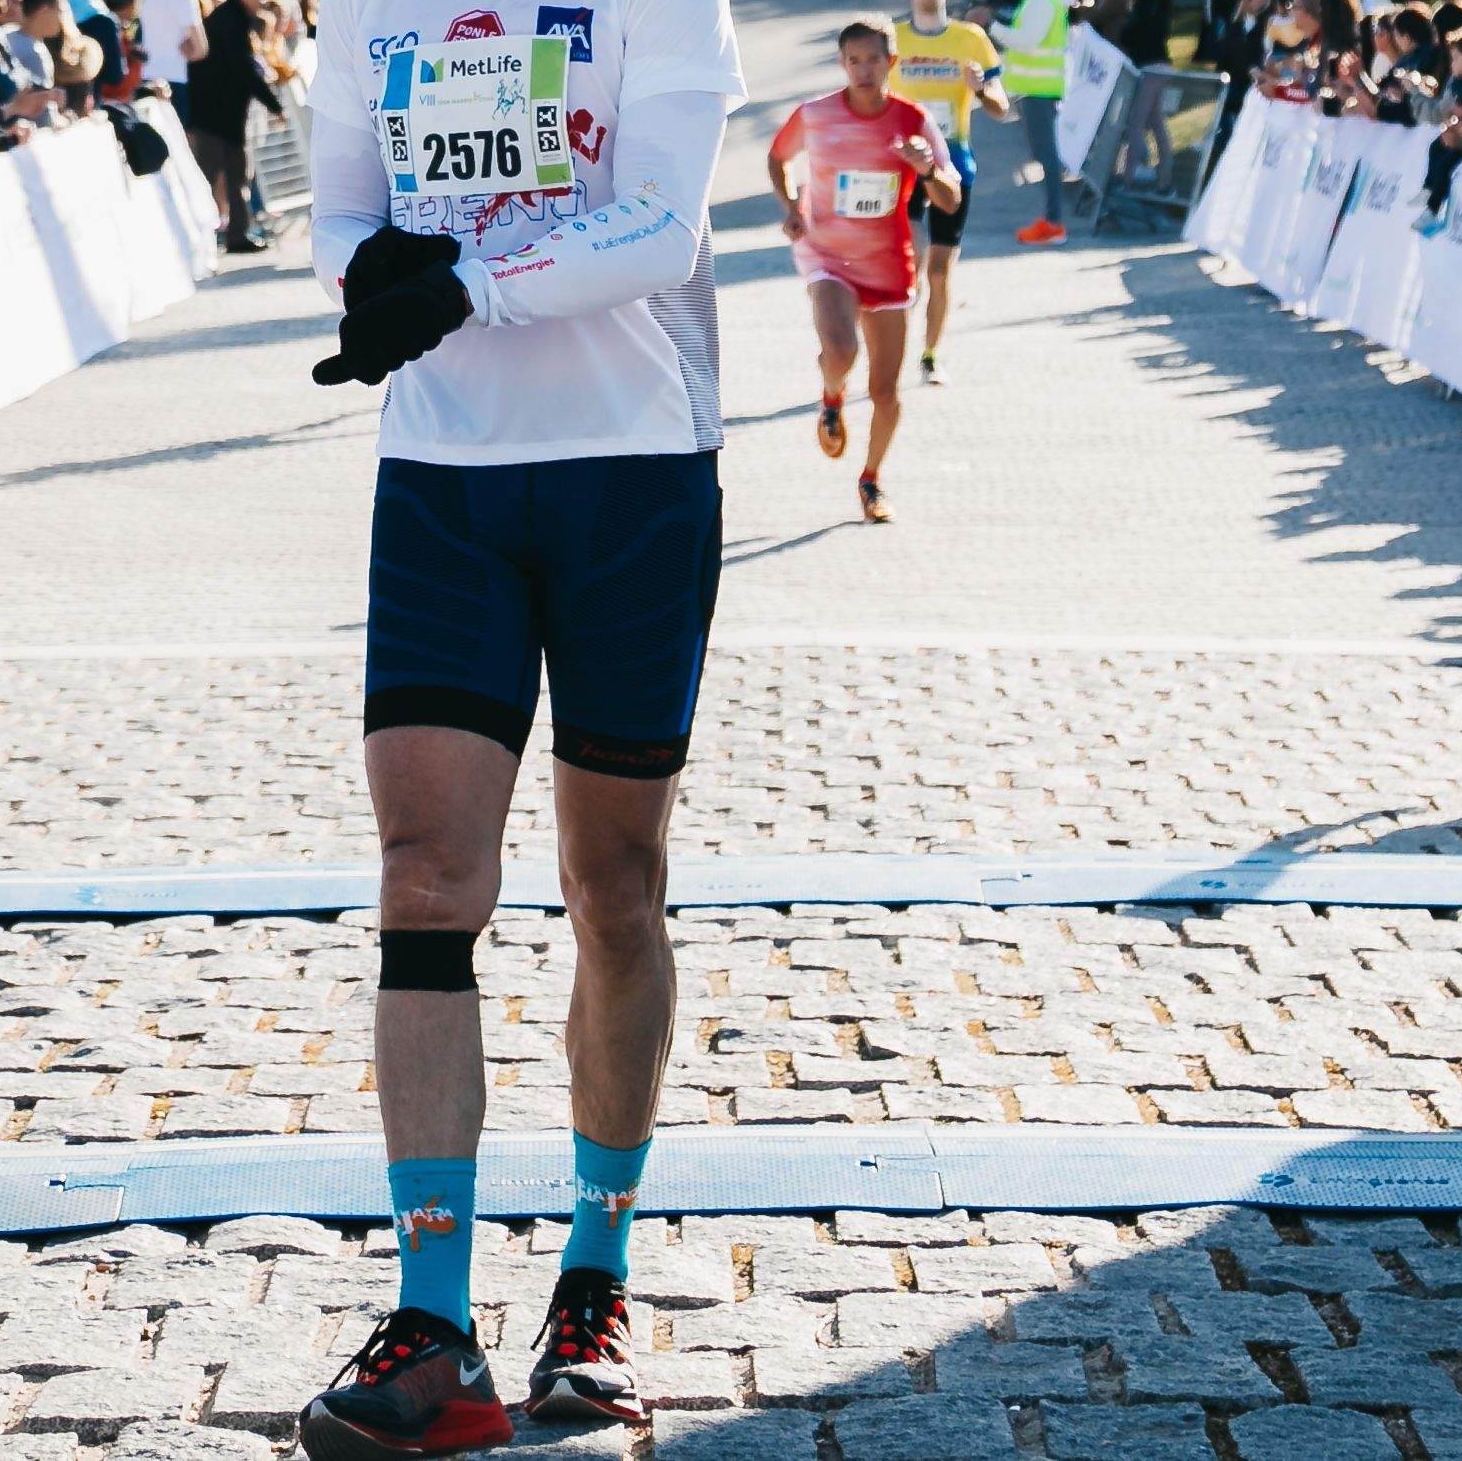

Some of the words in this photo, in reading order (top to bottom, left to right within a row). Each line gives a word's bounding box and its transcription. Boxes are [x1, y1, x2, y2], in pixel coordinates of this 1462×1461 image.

[450, 54, 523, 78] MetLife
[423, 127, 523, 182] 2576
[491, 257, 556, 281] TotalEnergies
